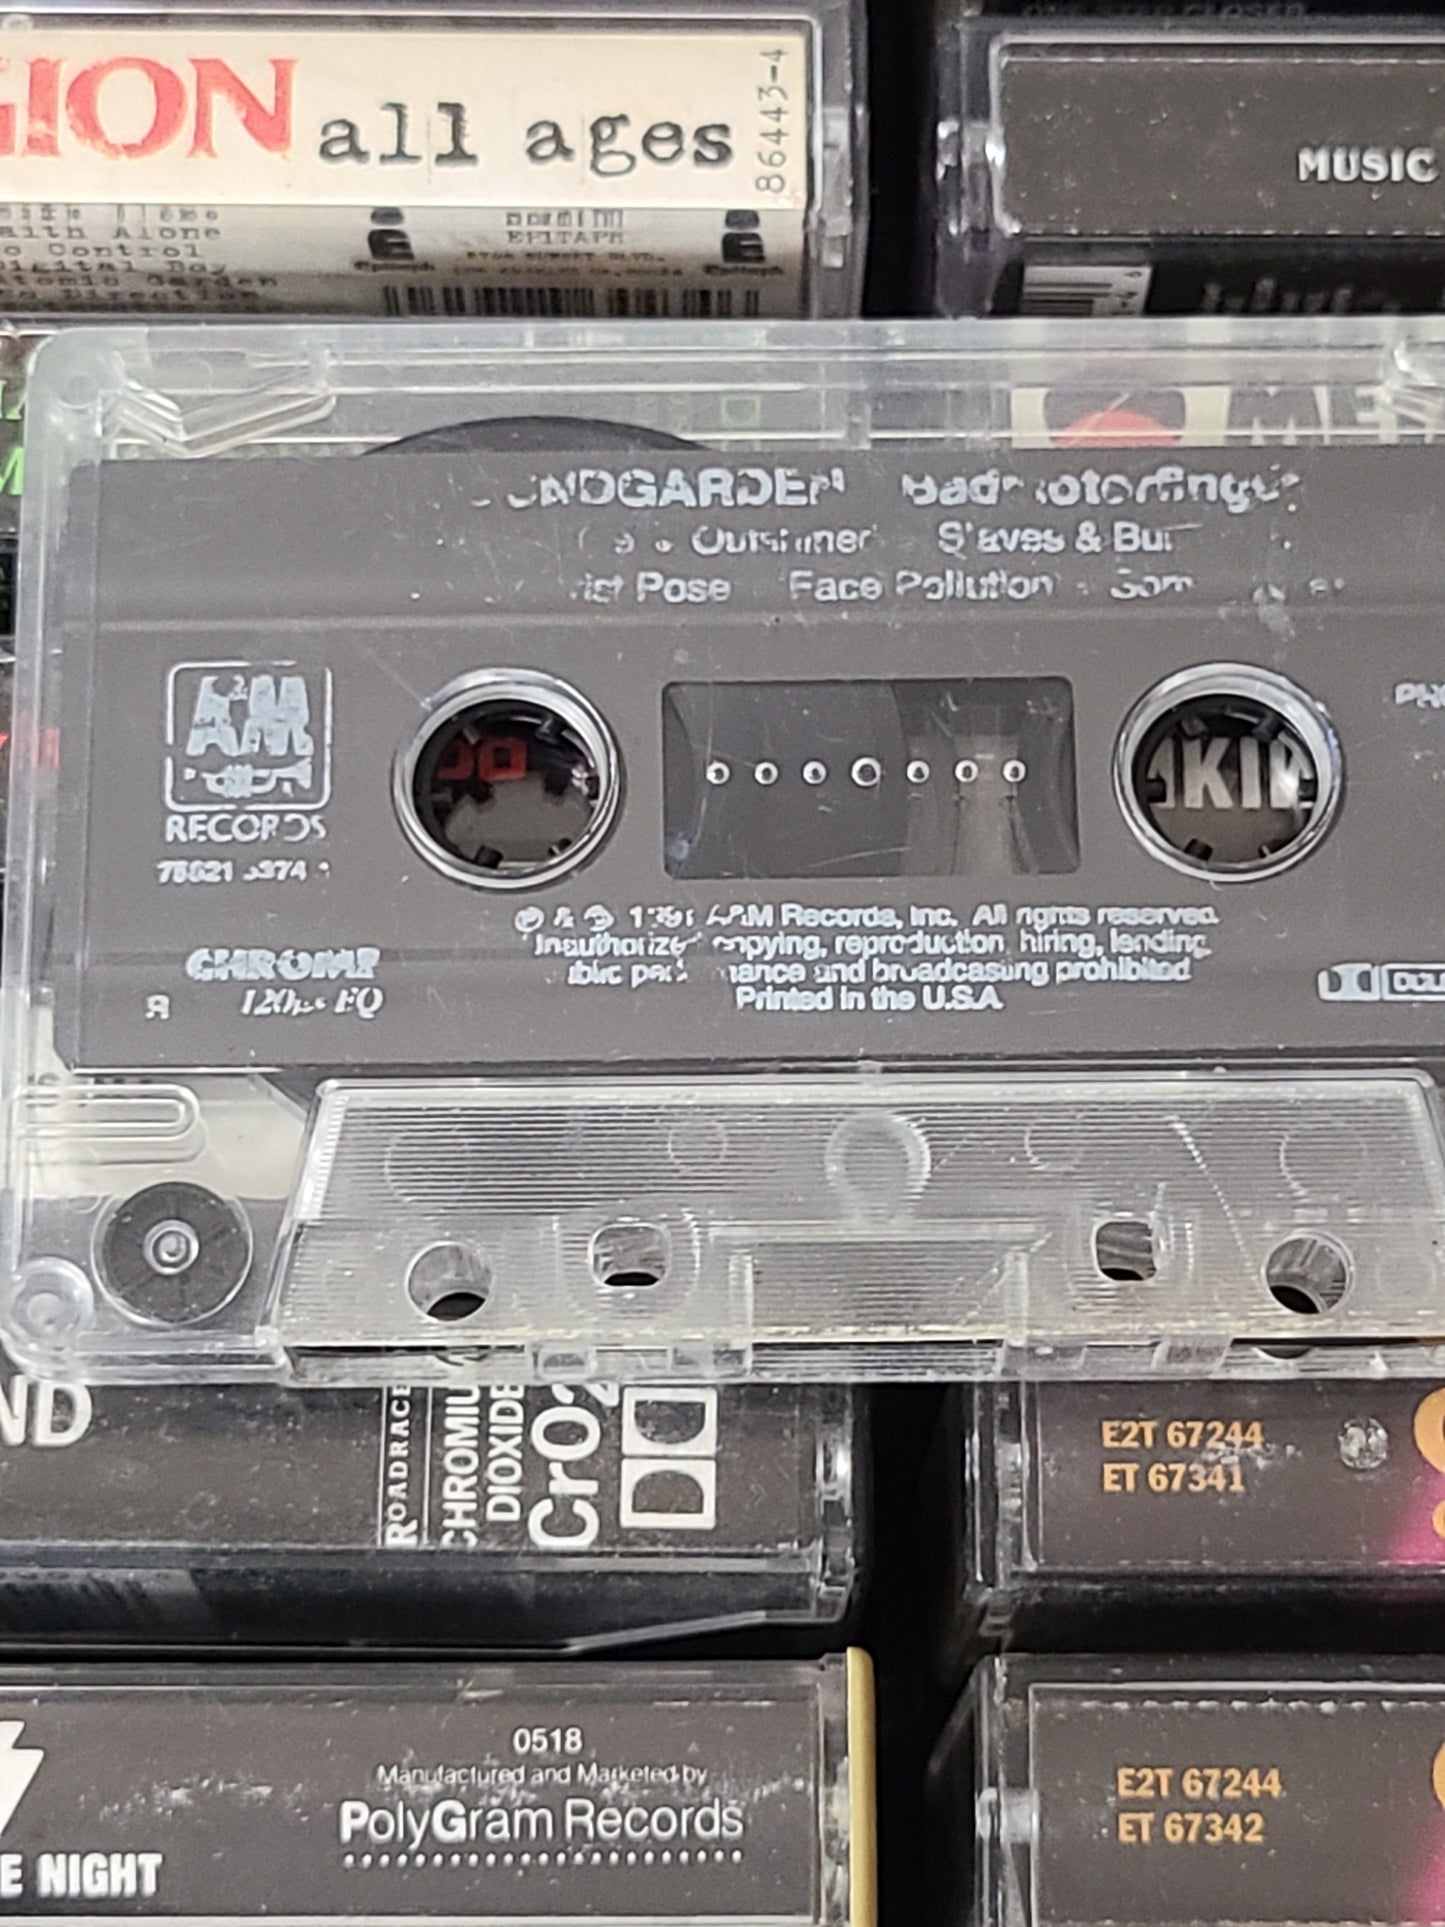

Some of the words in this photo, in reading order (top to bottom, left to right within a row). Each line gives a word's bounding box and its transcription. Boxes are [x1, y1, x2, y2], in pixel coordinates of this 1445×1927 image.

[0, 57, 297, 159] ION
[319, 102, 478, 166] all
[526, 114, 733, 176] ages
[754, 48, 789, 194] 86443-4
[1299, 147, 1439, 183] MUSIC
[112, 226, 221, 240] Alone
[508, 231, 624, 245] EPITAPH
[49, 243, 201, 258] Control
[0, 260, 138, 273] igital
[938, 520, 1066, 552] Saves
[1075, 520, 1102, 552] &
[637, 571, 732, 603] Pose
[789, 570, 883, 601] Face
[165, 813, 327, 843] RECORDS
[911, 905, 958, 927] Inc.
[972, 904, 1008, 926] All
[813, 958, 866, 984] and
[736, 984, 834, 1011] Printed
[871, 985, 916, 1011] the
[1102, 1421, 1158, 1448] E2T
[1167, 1421, 1265, 1450] 67244
[1103, 1463, 1140, 1492] ET
[1148, 1463, 1245, 1492] 67341
[513, 1727, 583, 1755] 0518
[376, 1764, 526, 1785] Manufactured
[531, 1765, 571, 1784] and
[577, 1762, 678, 1785] Marketed
[683, 1764, 707, 1785] by
[1117, 1768, 1174, 1797] E2T
[1182, 1768, 1282, 1798] 67244
[340, 1800, 553, 1850] PolyGram
[565, 1799, 744, 1843] Records
[1118, 1813, 1155, 1842] ET
[1164, 1813, 1265, 1843] 67342
[37, 1853, 163, 1898] NIGHT
